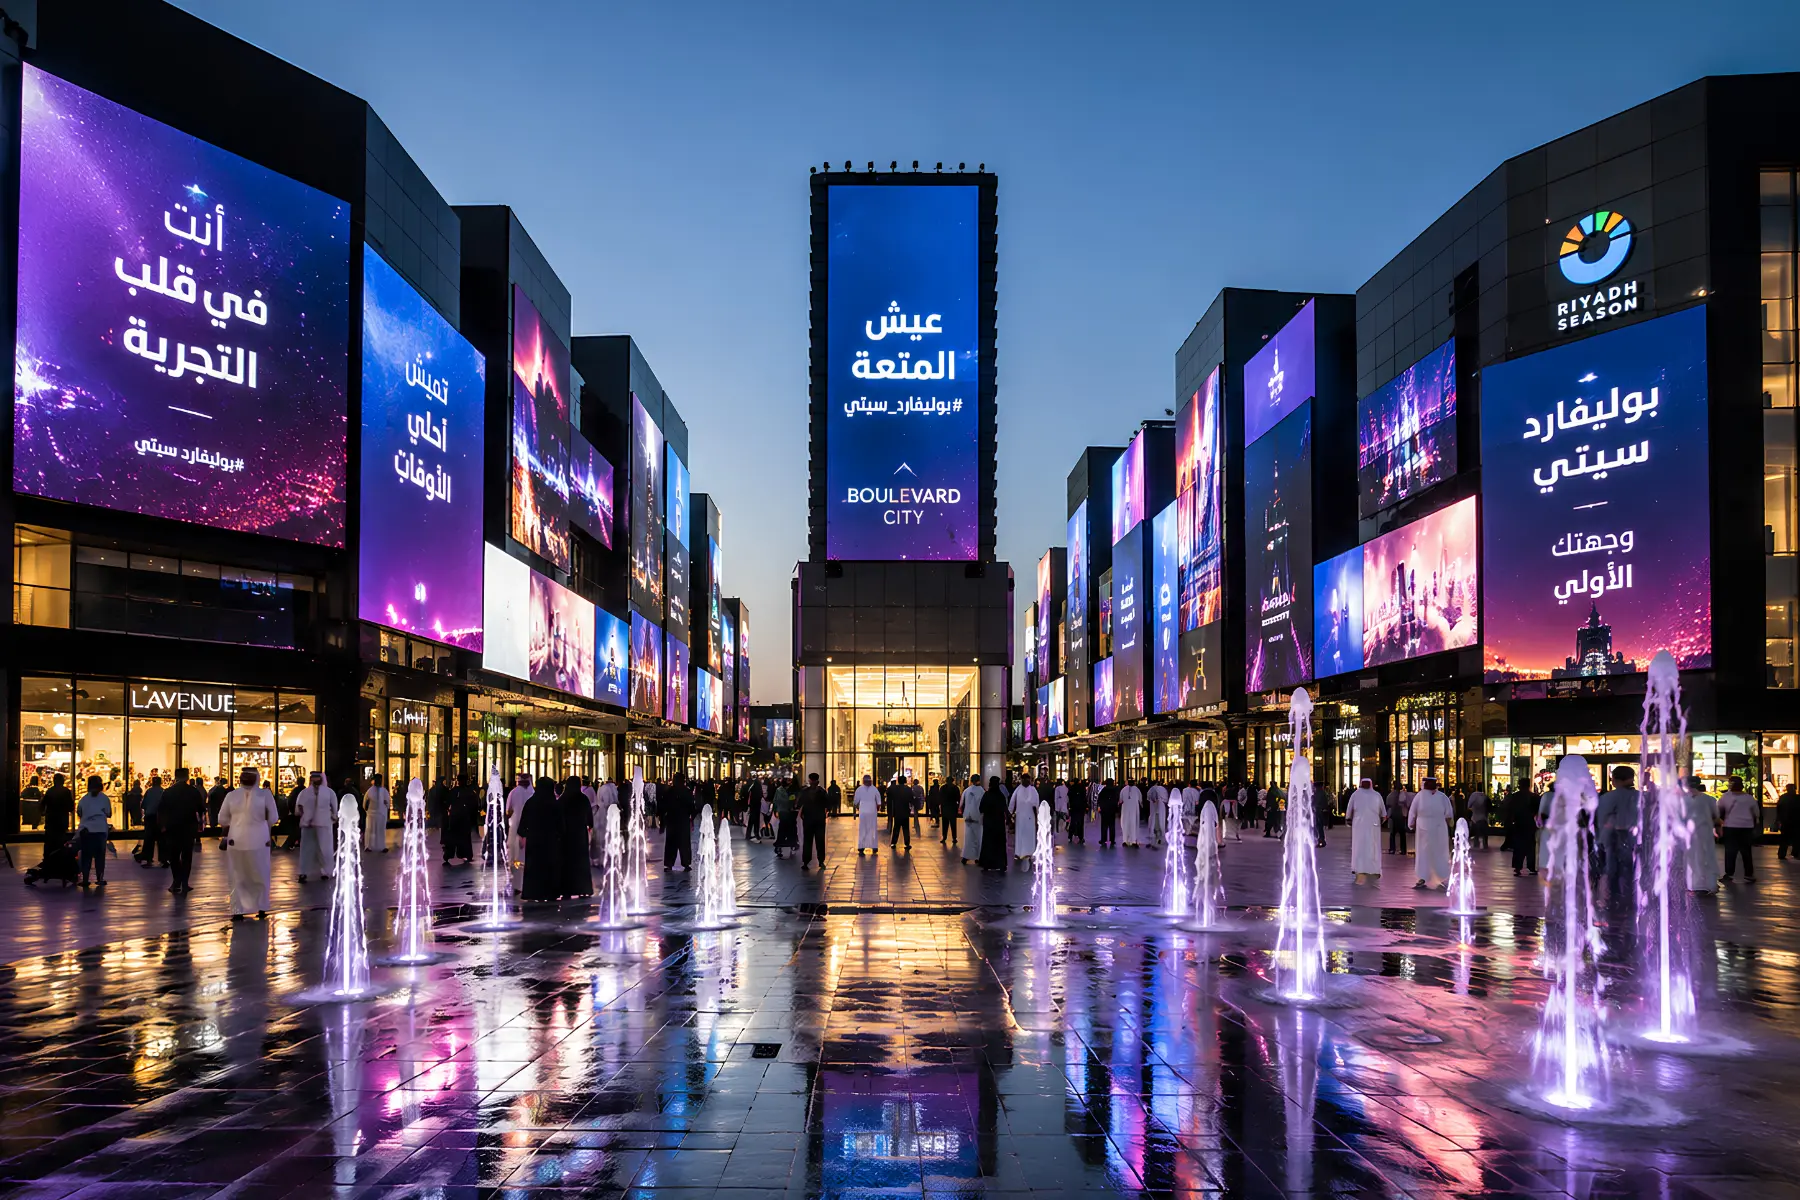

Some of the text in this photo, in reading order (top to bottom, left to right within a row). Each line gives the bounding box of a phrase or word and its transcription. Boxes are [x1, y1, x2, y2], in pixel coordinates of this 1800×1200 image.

[164, 203, 225, 251] أنت
[114, 255, 268, 329] في قلب
[1557, 280, 1637, 316] RIYADH
[866, 301, 942, 340] عيش
[1557, 296, 1638, 331] SEASON
[852, 351, 954, 380] المتعة
[844, 396, 963, 417] #بوليفارد_سيتي
[1523, 387, 1659, 442] بوليفارد
[134, 438, 178, 458] سيتي
[1533, 440, 1649, 494] سيتي
[847, 488, 961, 503] BOULEVARD
[883, 509, 924, 525] CITY
[1551, 530, 1634, 557] وجهتك
[1553, 561, 1633, 604] الأولي
[132, 685, 238, 713] L'AVENUE
